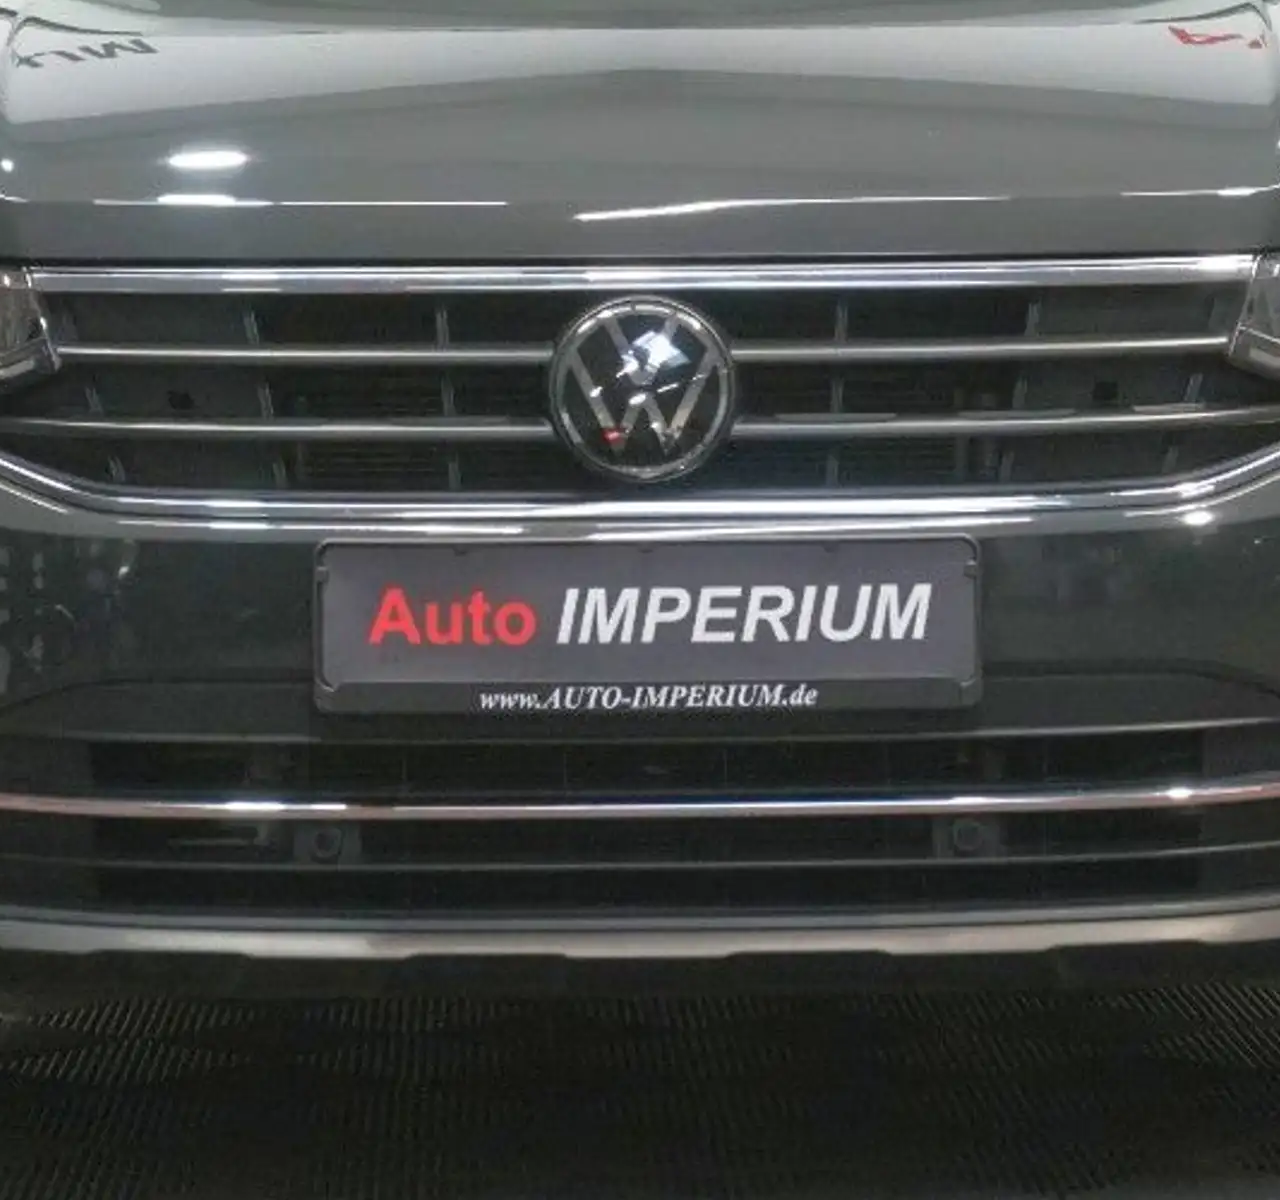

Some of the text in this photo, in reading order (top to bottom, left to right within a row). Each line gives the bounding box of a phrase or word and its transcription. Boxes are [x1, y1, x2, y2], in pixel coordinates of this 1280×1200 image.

[369, 584, 931, 646] Auto IMPERIUM
[480, 683, 818, 710] www.AUTO-IMPERIUM.de
